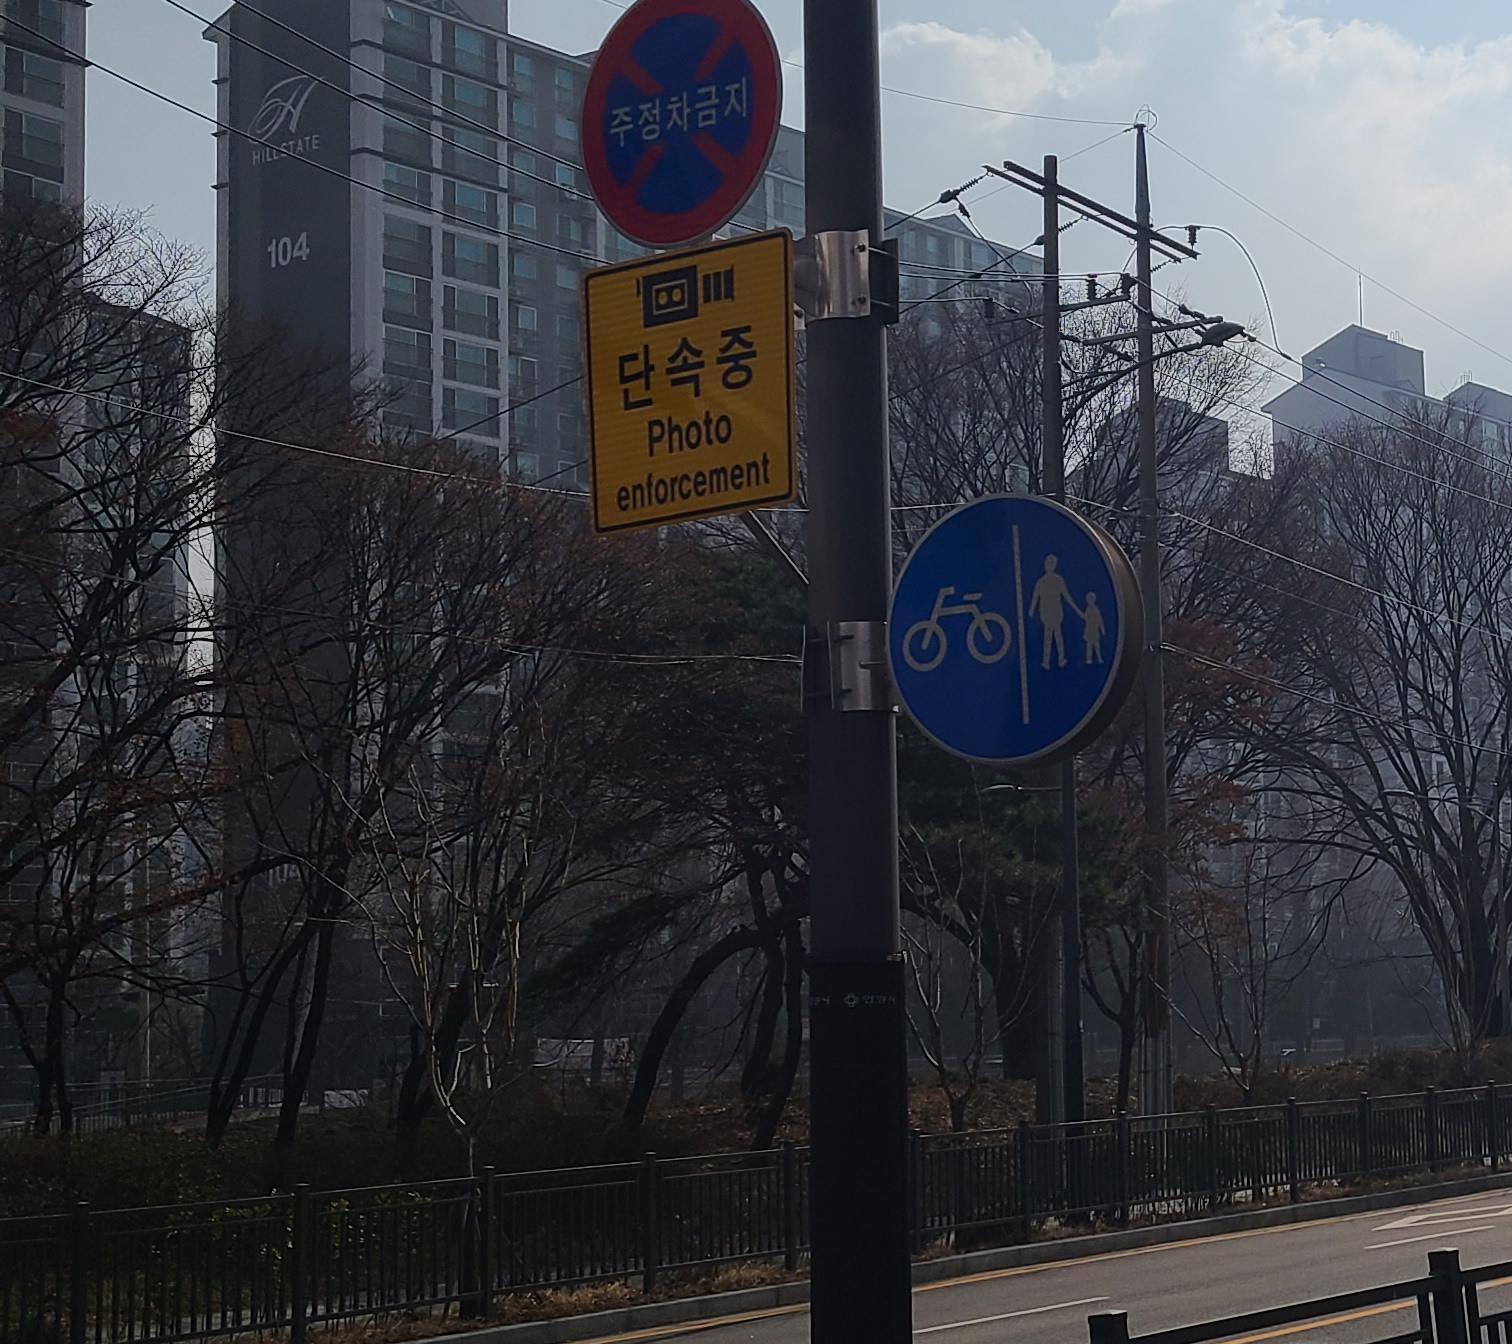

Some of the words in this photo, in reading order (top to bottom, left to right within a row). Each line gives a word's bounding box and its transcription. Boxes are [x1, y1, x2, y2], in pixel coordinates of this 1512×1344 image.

[608, 75, 750, 149] 주정차금지
[251, 134, 321, 167] HILLSTATE
[267, 231, 310, 268] 104
[618, 325, 758, 411] 단속중
[647, 410, 733, 458] Photo
[616, 452, 770, 512] enforcement
